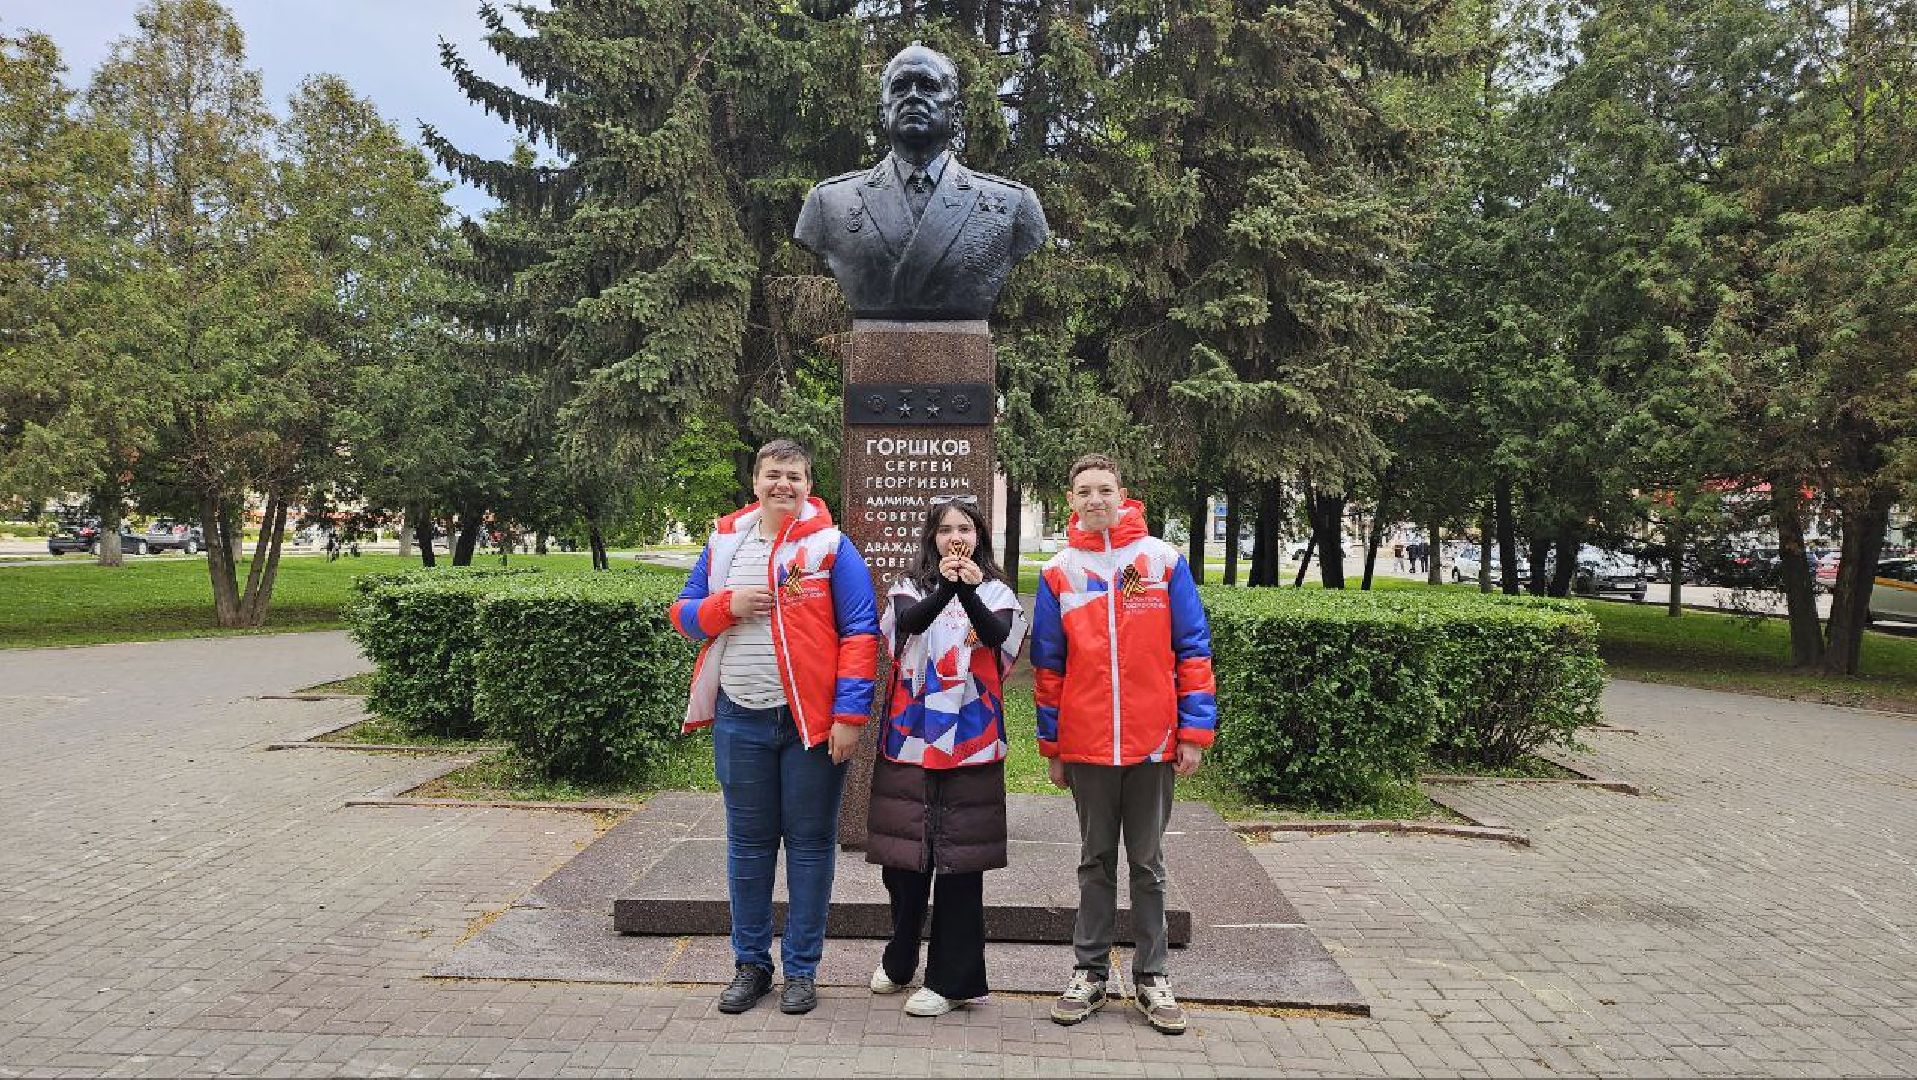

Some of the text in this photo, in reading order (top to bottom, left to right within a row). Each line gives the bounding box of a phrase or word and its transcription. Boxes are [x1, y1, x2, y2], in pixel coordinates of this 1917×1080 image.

[866, 437, 971, 456] ГОРШКОВ
[885, 459, 952, 472] СЕРГЕЙ
[866, 476, 969, 489] ГЕОРГИЕВИЧ
[866, 496, 925, 507] АДМИРАЛ
[864, 511, 927, 522] СОВЕТС
